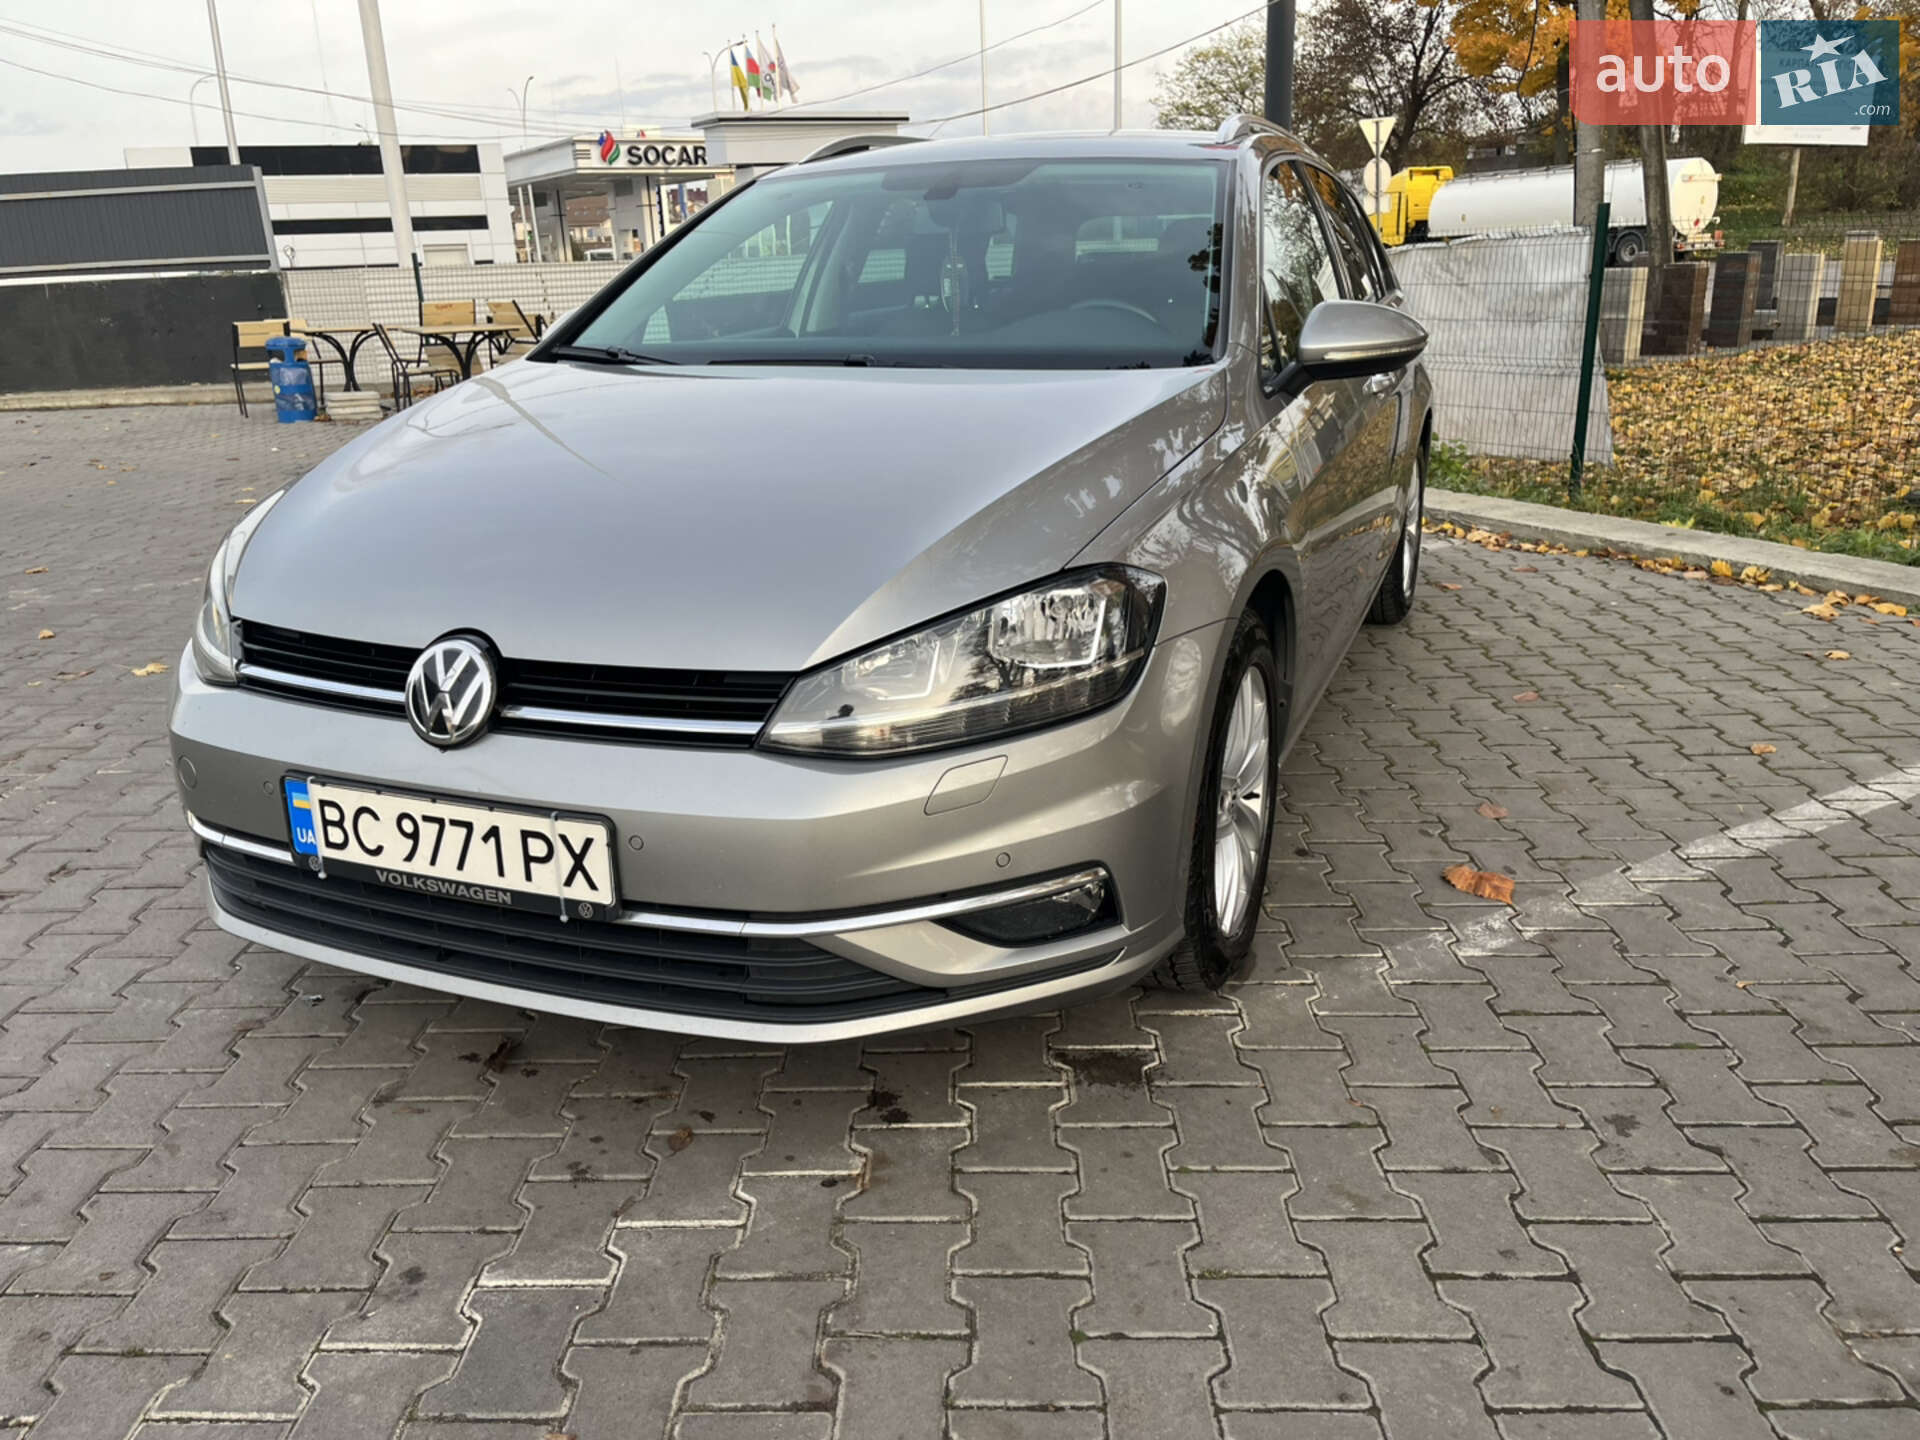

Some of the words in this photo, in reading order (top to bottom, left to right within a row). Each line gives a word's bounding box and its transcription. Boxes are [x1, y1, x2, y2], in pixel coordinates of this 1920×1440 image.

[627, 144, 708, 166] SOCAR
[296, 826, 317, 846] UA
[318, 798, 385, 857] BC
[396, 812, 506, 878] 9771
[520, 829, 599, 892] PX
[375, 869, 512, 905] VOLKSWAGEN
